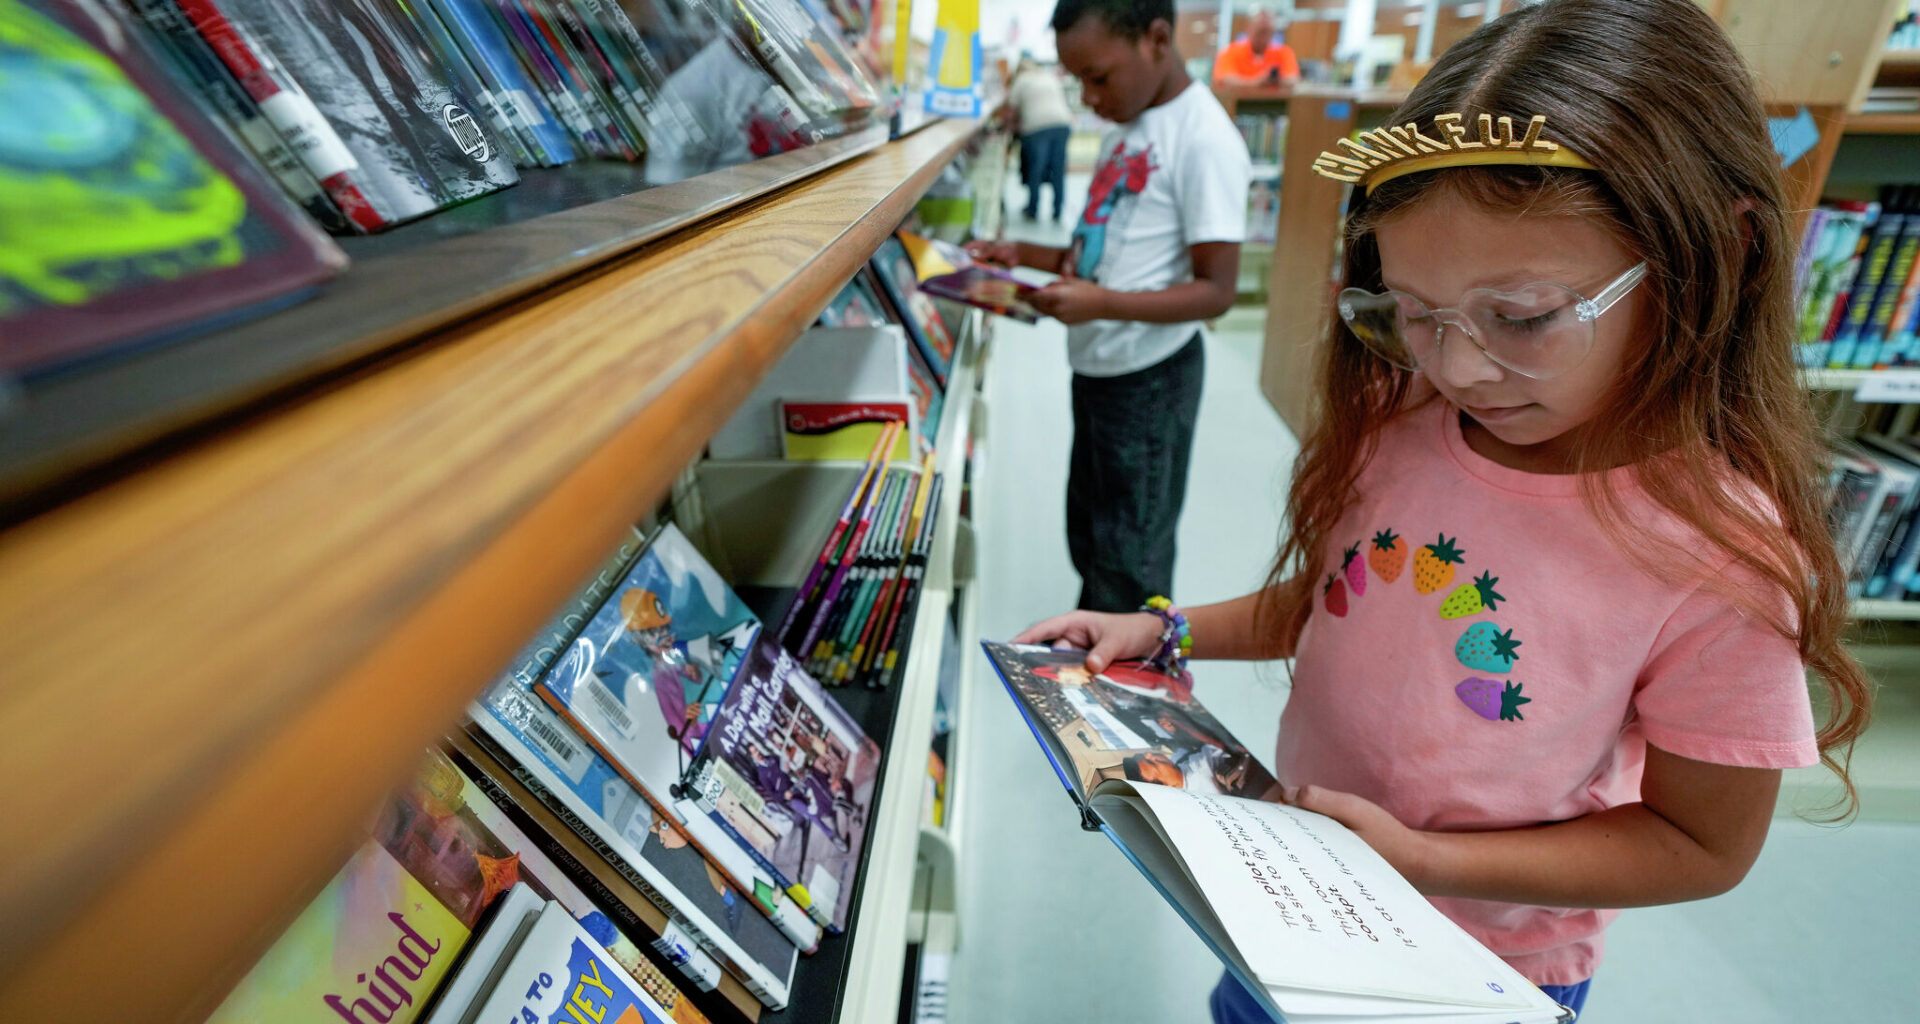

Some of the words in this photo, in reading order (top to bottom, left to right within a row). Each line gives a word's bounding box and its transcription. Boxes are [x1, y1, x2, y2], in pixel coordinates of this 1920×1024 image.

[724, 711, 748, 743] Day
[748, 694, 775, 738] Mail
[719, 737, 735, 753] A
[1215, 819, 1250, 858] shows
[1233, 823, 1254, 842] the
[559, 806, 606, 852] SEPARATE
[606, 850, 620, 865] IS
[618, 860, 651, 893] NEVER
[649, 887, 681, 920] EQUAL
[1250, 845, 1269, 862] fly
[1287, 853, 1300, 864] is
[1322, 847, 1354, 876] front
[1245, 860, 1281, 897] pilot
[1266, 865, 1282, 881] to
[1298, 867, 1333, 904] room
[1280, 884, 1304, 910] sits
[1353, 879, 1376, 902] the
[1275, 900, 1299, 929] The
[1301, 913, 1322, 933] he
[1328, 883, 1380, 943] cockpit.
[1330, 908, 1359, 938] This
[1374, 905, 1393, 922] at
[1392, 926, 1418, 948] It's
[525, 972, 553, 1001] TO
